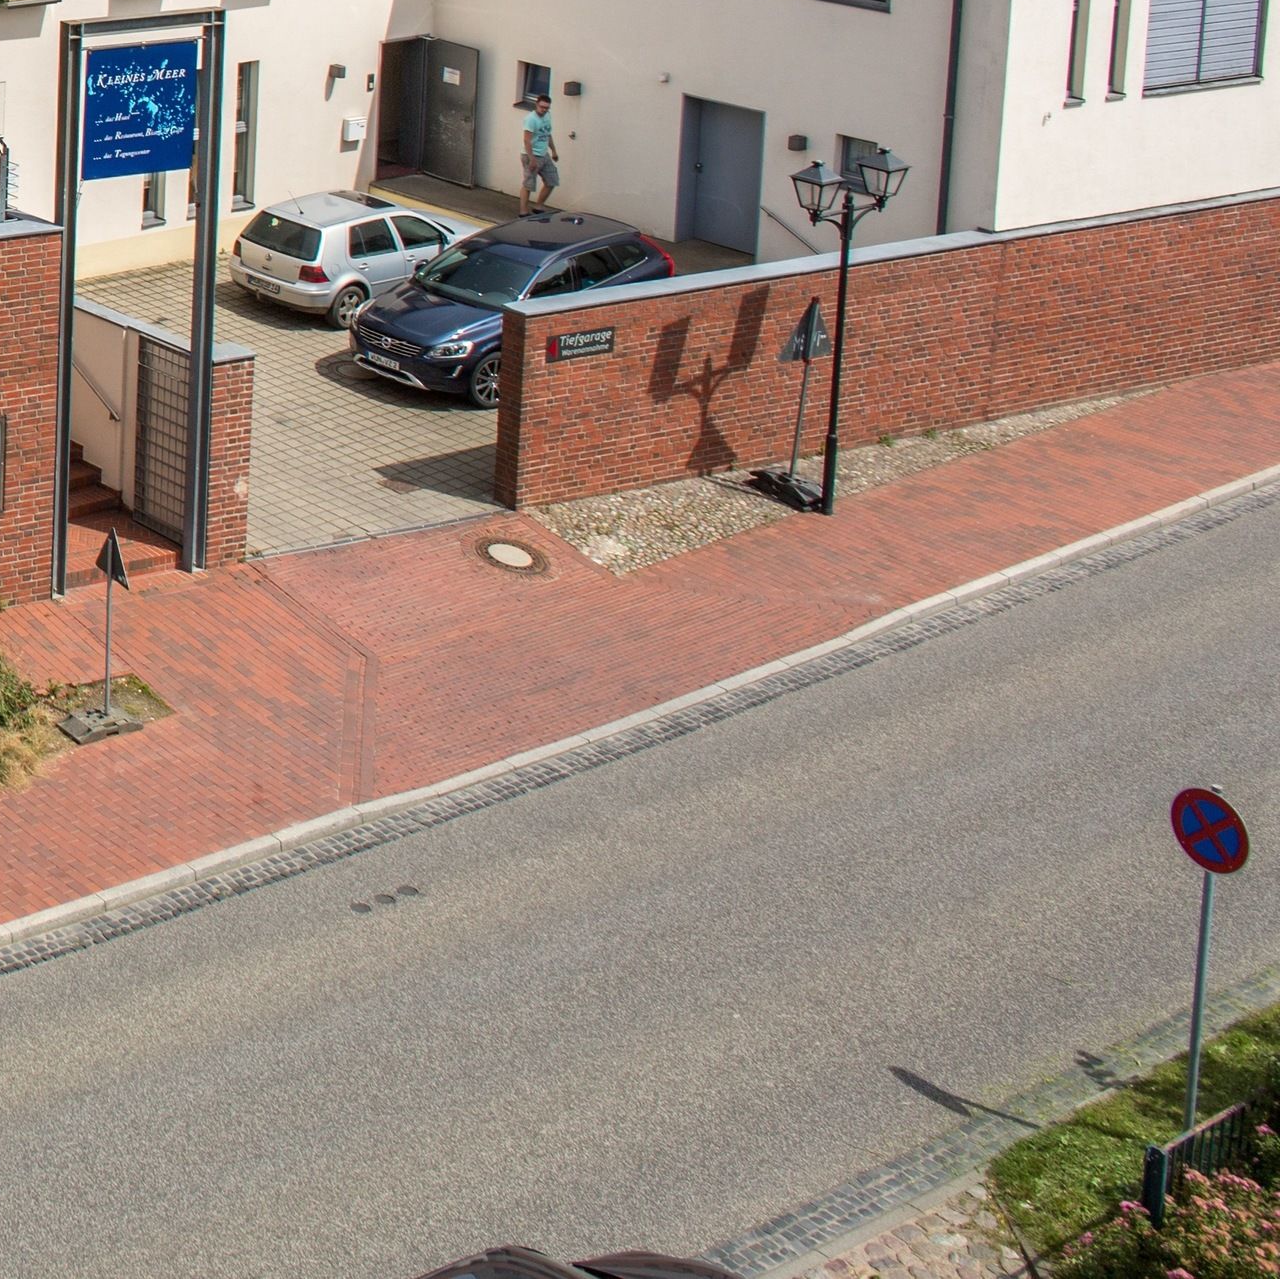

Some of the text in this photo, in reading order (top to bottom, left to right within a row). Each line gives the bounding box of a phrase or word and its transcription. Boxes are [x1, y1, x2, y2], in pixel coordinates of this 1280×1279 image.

[96, 68, 187, 89] KLEINES MEER
[559, 330, 613, 347] Tiefgarage
